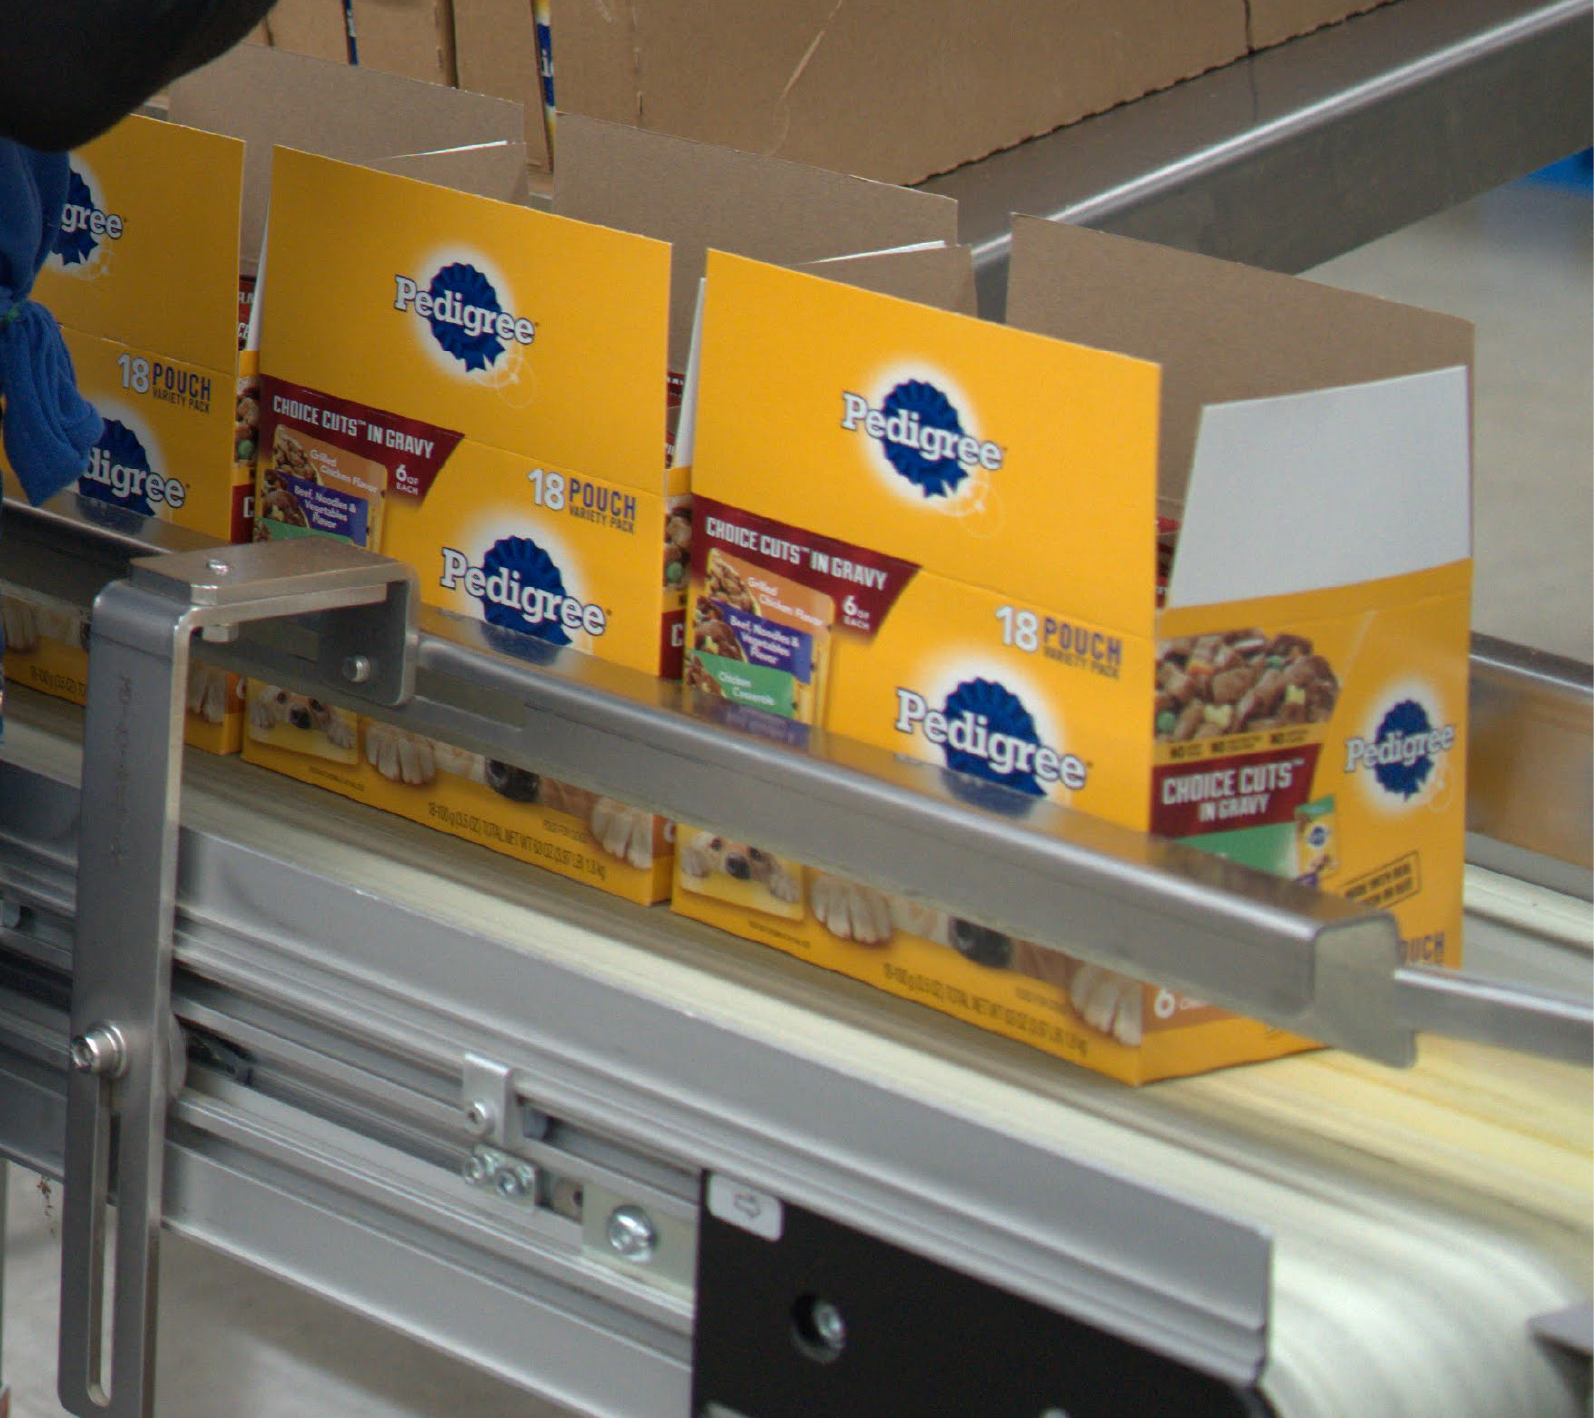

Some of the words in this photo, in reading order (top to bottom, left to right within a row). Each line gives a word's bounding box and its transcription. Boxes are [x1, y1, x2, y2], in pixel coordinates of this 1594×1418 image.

[394, 274, 535, 345] Pedigree
[117, 352, 150, 394] 18
[152, 362, 212, 402] POUCH
[152, 386, 186, 408] VARIETY
[188, 397, 210, 414] PACK
[273, 394, 320, 425] CHOICE
[367, 423, 383, 445] IN
[385, 429, 435, 459] GRAVY
[840, 391, 1005, 470] Pedigree
[395, 464, 408, 482] 6
[396, 482, 419, 496] EACH
[527, 467, 565, 511] 18
[569, 477, 637, 521] POUCH
[569, 505, 607, 529] VARIETY
[610, 515, 635, 535] PACK
[706, 516, 759, 551] CHOICE
[811, 551, 829, 574] IN
[831, 557, 888, 591] GRAVY
[440, 547, 606, 637] Pedigree
[842, 595, 857, 616] 6
[995, 605, 1039, 653] 18
[1043, 616, 1122, 666] POUCH
[894, 686, 1087, 791] Pedigree
[1344, 723, 1456, 773] Pedigree
[1162, 769, 1235, 805] CHOICE
[1198, 801, 1217, 823] IN
[1218, 794, 1271, 820] GRAVY
